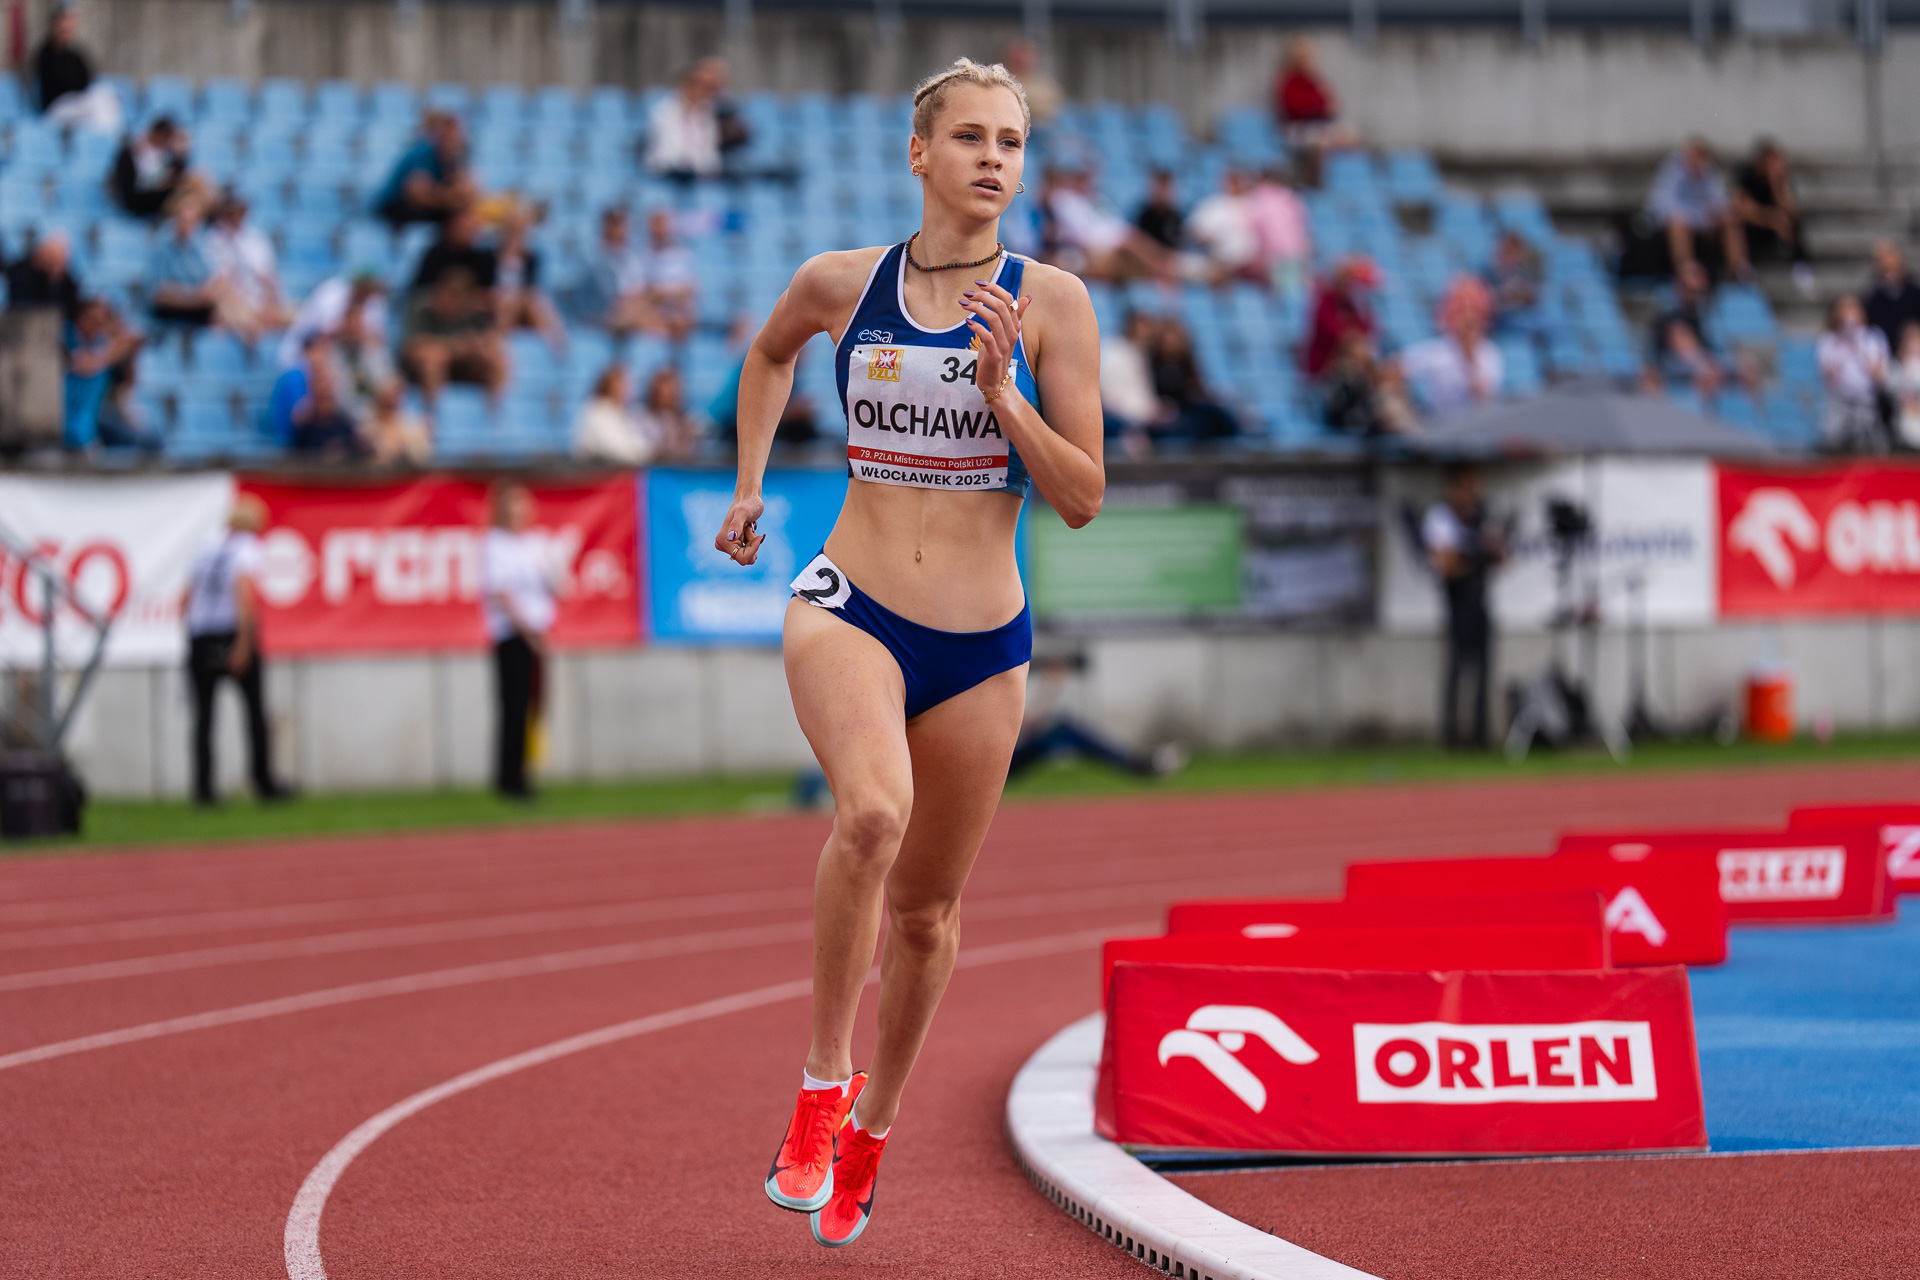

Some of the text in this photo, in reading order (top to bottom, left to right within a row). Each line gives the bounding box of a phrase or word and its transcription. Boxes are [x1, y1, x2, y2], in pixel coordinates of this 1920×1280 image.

[870, 368, 898, 381] PZLA
[854, 399, 1003, 440] OLCHAWA
[860, 449, 993, 469] 79. PZLA Mistrzostwa Polski U20
[860, 465, 990, 486] WŁOCŁAWEK 2025
[799, 567, 840, 605] 2
[1374, 1035, 1634, 1090] ORLEN
